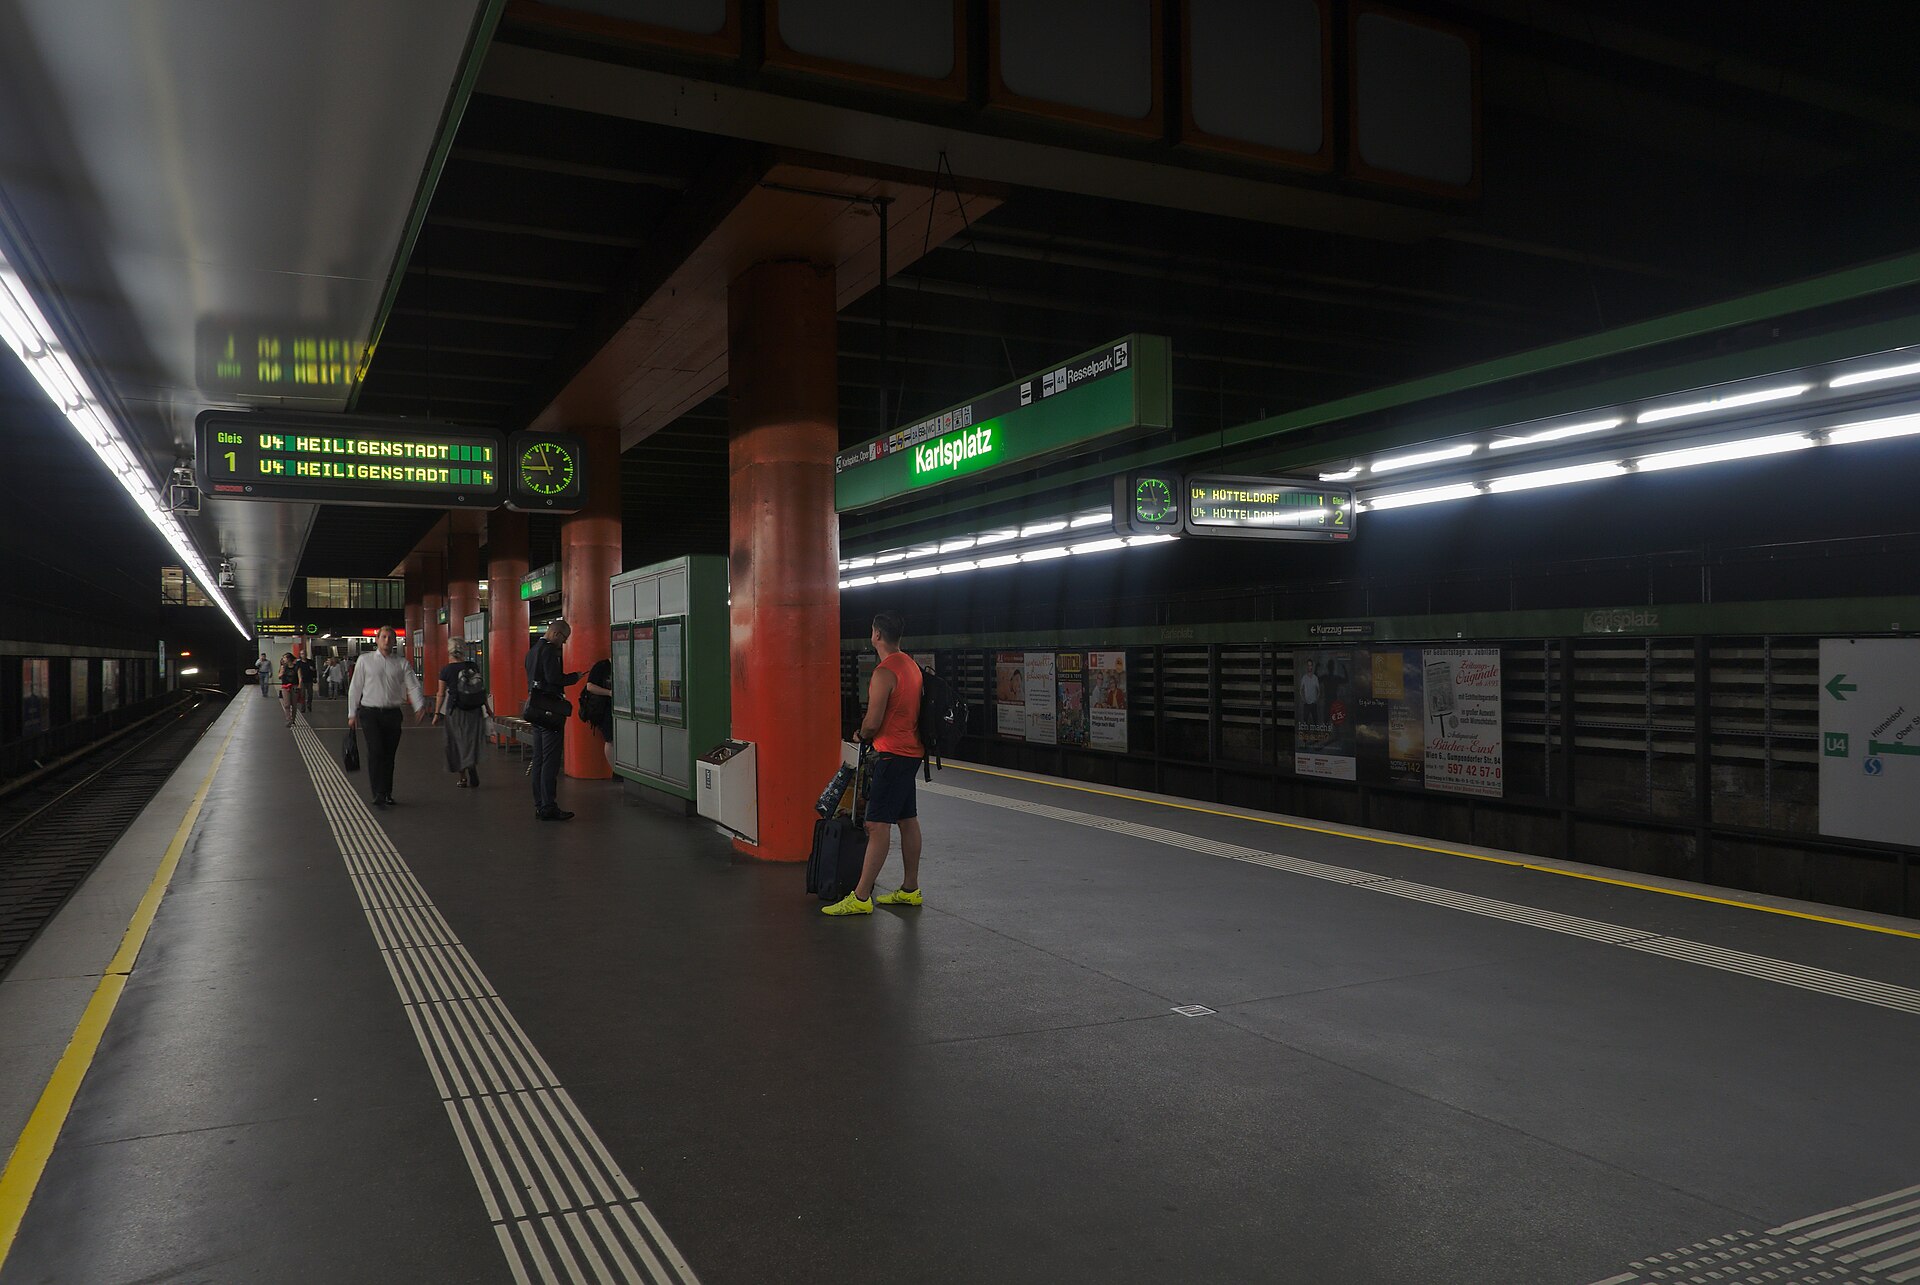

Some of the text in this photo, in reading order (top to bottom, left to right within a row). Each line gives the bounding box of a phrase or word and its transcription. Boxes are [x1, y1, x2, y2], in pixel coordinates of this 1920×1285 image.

[1057, 354, 1113, 385] 4A Resselpark
[217, 432, 243, 444] Gleis
[260, 434, 491, 461] U4 HEILIGENSTADT 1
[915, 427, 993, 474] Karlsplatz
[224, 451, 236, 472] 1
[260, 459, 493, 484] U4 HEILIGENSTADT 4
[1192, 488, 1206, 499] U4
[1212, 489, 1280, 504] HÜTTELDORF
[1319, 496, 1323, 506] 1
[1192, 507, 1206, 518] U4
[1334, 510, 1344, 525] 2
[1584, 610, 1661, 631] Karlsplatz
[1316, 625, 1342, 635] Kurzzug
[1456, 664, 1499, 686] Originale
[1298, 721, 1309, 731] Ich
[1871, 706, 1905, 738] Hütteldorf
[1896, 724, 1914, 740] Ober
[1826, 737, 1847, 752] U4
[1447, 753, 1483, 763] Gumpendorfer
[1408, 762, 1421, 773] 142
[1447, 763, 1463, 775] 597
[1466, 765, 1477, 776] 42
[1480, 766, 1501, 779] 57-0
